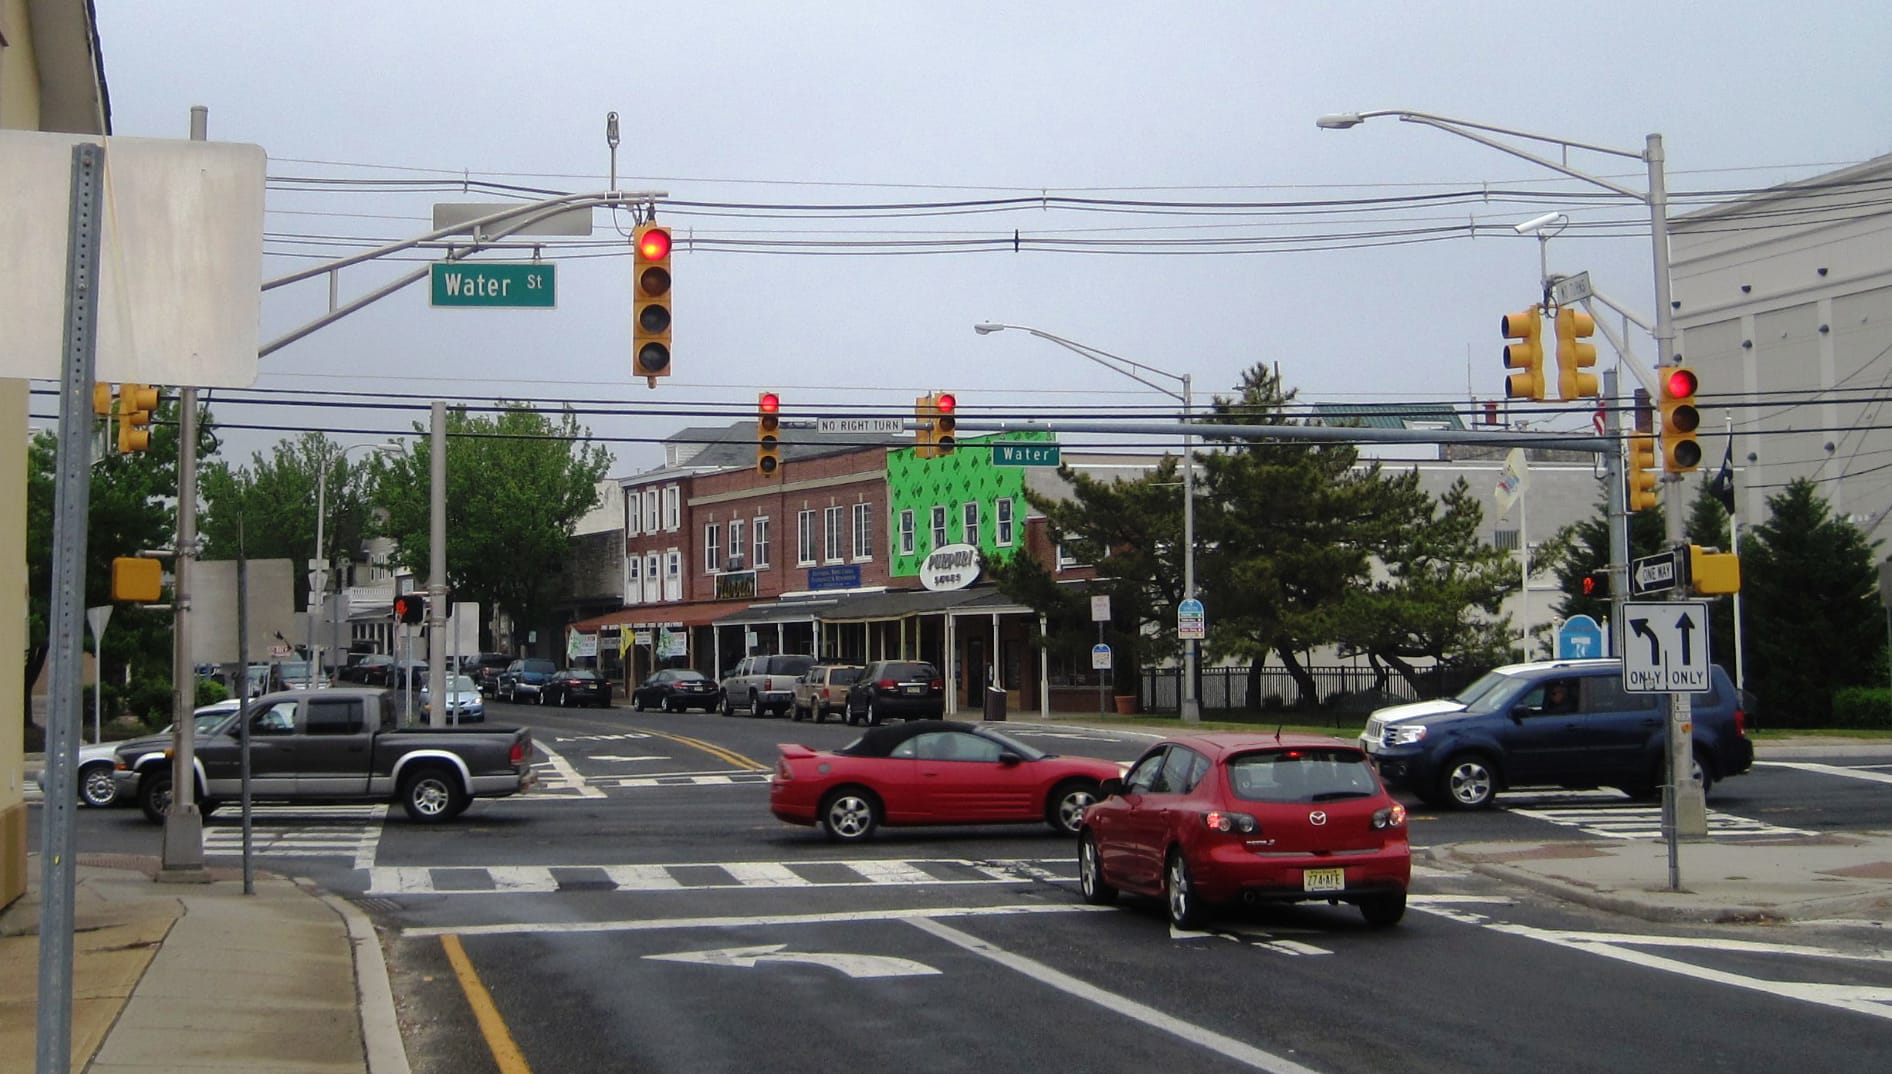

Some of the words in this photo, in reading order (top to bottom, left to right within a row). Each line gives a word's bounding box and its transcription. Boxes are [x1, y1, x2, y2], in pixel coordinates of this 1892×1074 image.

[444, 273, 511, 296] Water
[527, 274, 542, 289] St
[822, 421, 836, 431] NO
[840, 421, 869, 431] RIGHT
[874, 421, 899, 431] TURN
[1003, 447, 1049, 461] Water
[1643, 567, 1657, 581] ONE
[1657, 563, 1671, 579] WAY
[1672, 671, 1703, 685] ONLY
